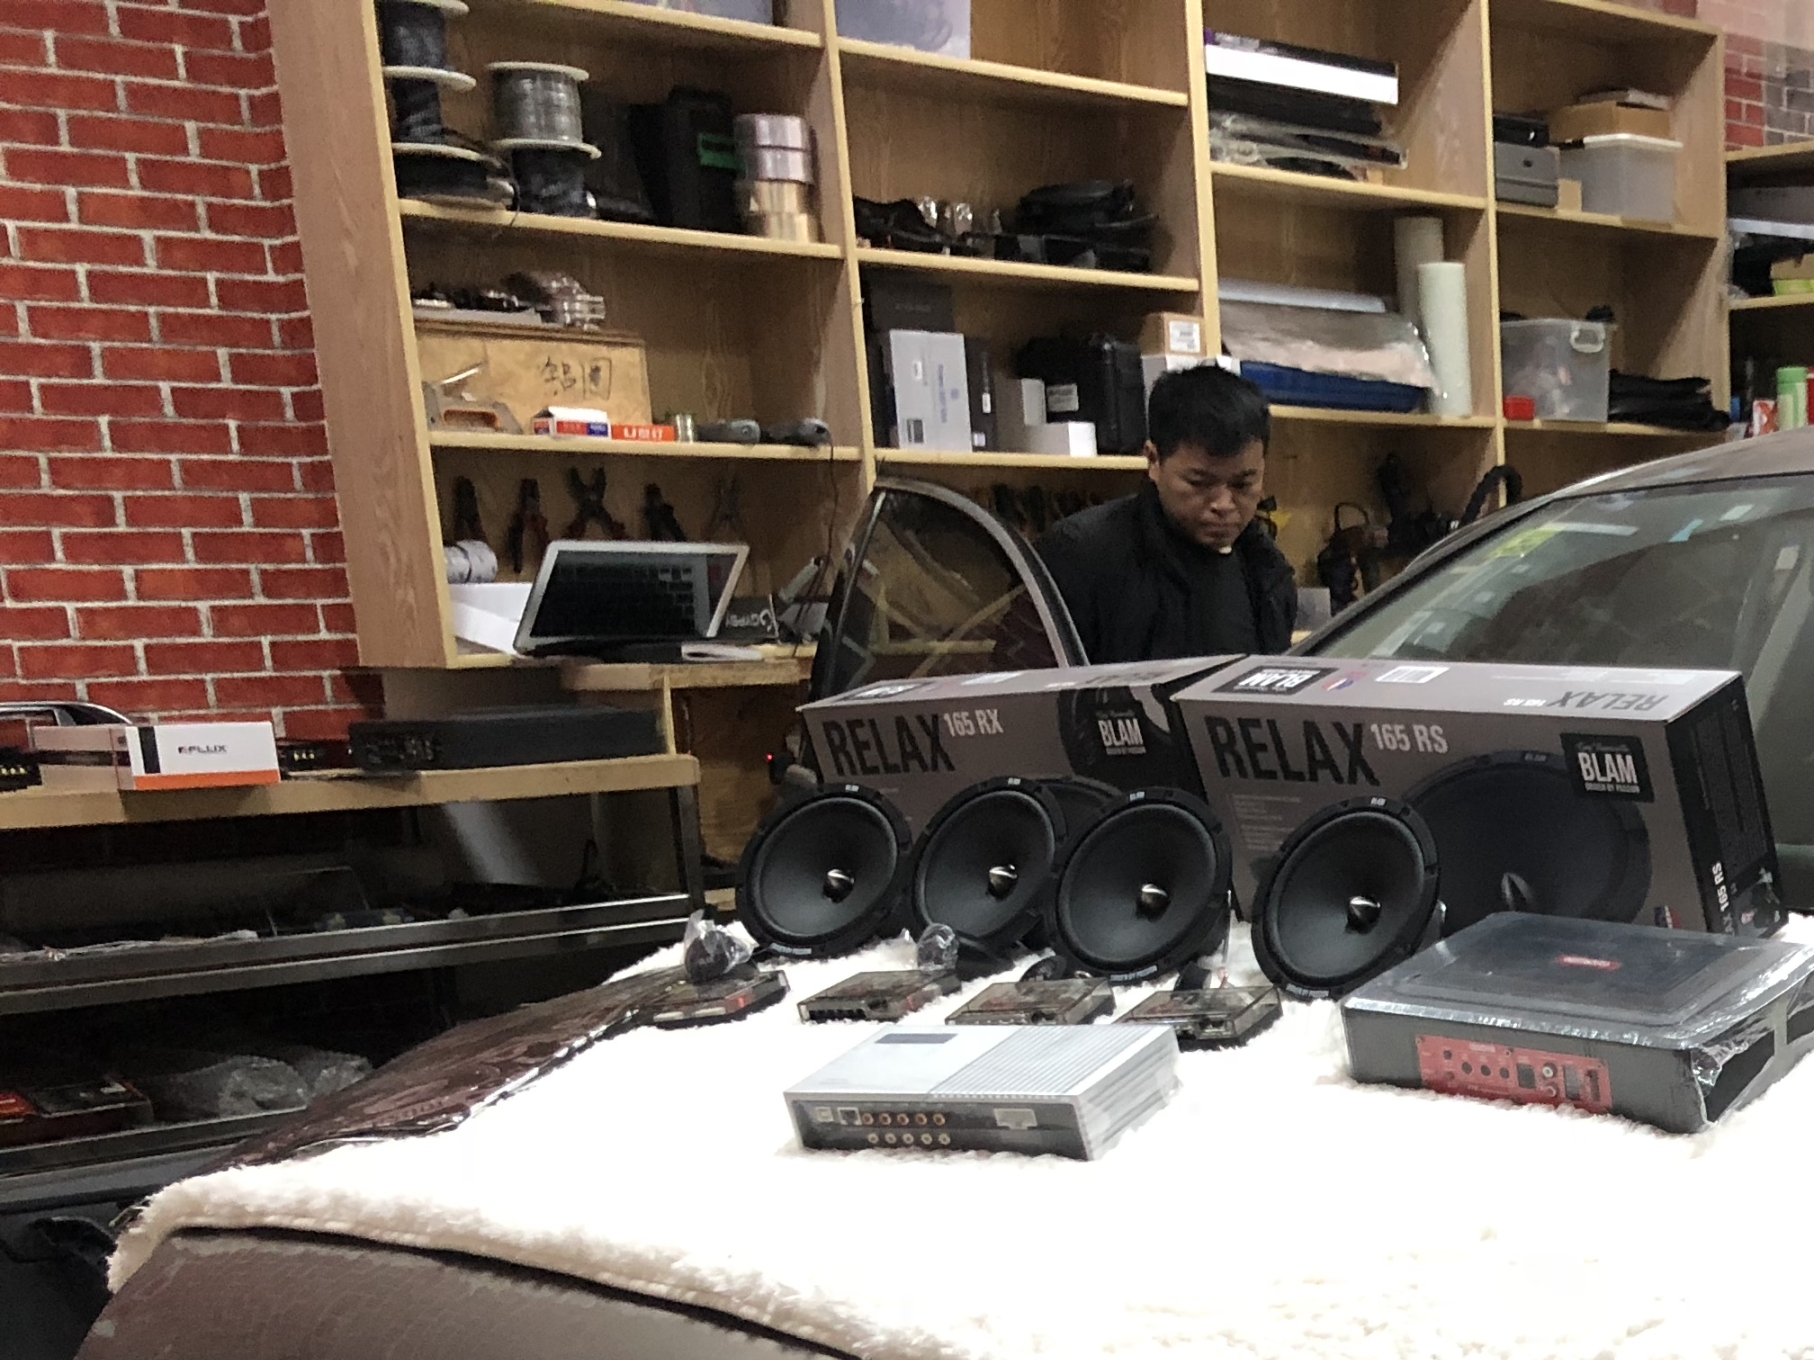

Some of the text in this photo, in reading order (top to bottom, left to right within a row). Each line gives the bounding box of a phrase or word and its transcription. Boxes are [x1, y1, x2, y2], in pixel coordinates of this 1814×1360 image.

[1547, 690, 1669, 712] RELAX
[822, 709, 1004, 777] RELAX 165 RX
[1098, 718, 1144, 747] BLAM
[1204, 715, 1449, 787] RELAX 165 RS
[1577, 751, 1638, 784] BLAM
[1711, 861, 1724, 886] RS
[1716, 885, 1729, 912] 165
